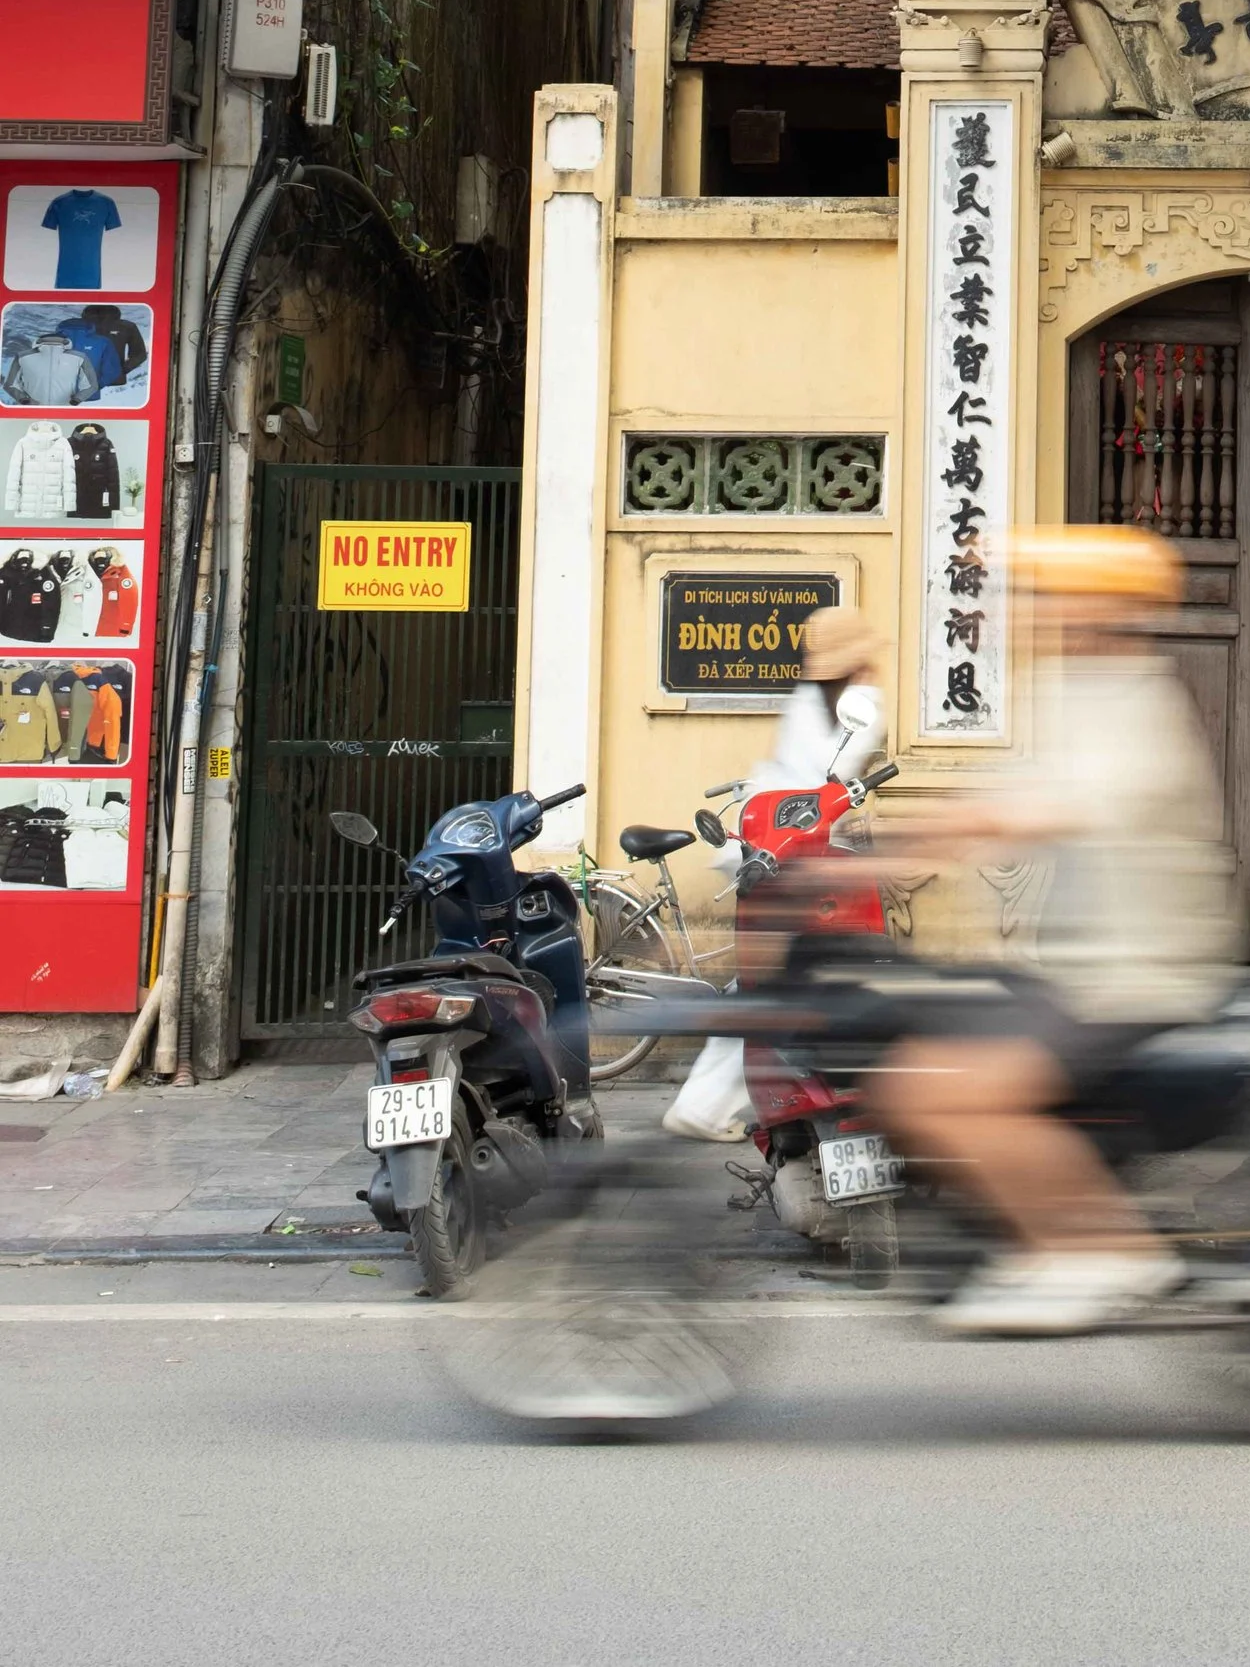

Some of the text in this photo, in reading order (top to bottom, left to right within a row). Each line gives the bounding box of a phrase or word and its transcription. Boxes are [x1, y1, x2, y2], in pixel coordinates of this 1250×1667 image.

[333, 535, 458, 567] NO ENTRY
[344, 578, 444, 597] KHÔNG VÀO
[684, 586, 819, 607] DI TÍCH LỊCH SỬ VĂN HÓA
[678, 615, 742, 651] ĐÌNH
[747, 608, 781, 651] CỔ
[698, 656, 802, 683] ĐÃ XẾP HẠNG
[381, 1084, 435, 1115] 29-C1
[375, 1111, 444, 1143] 914.48
